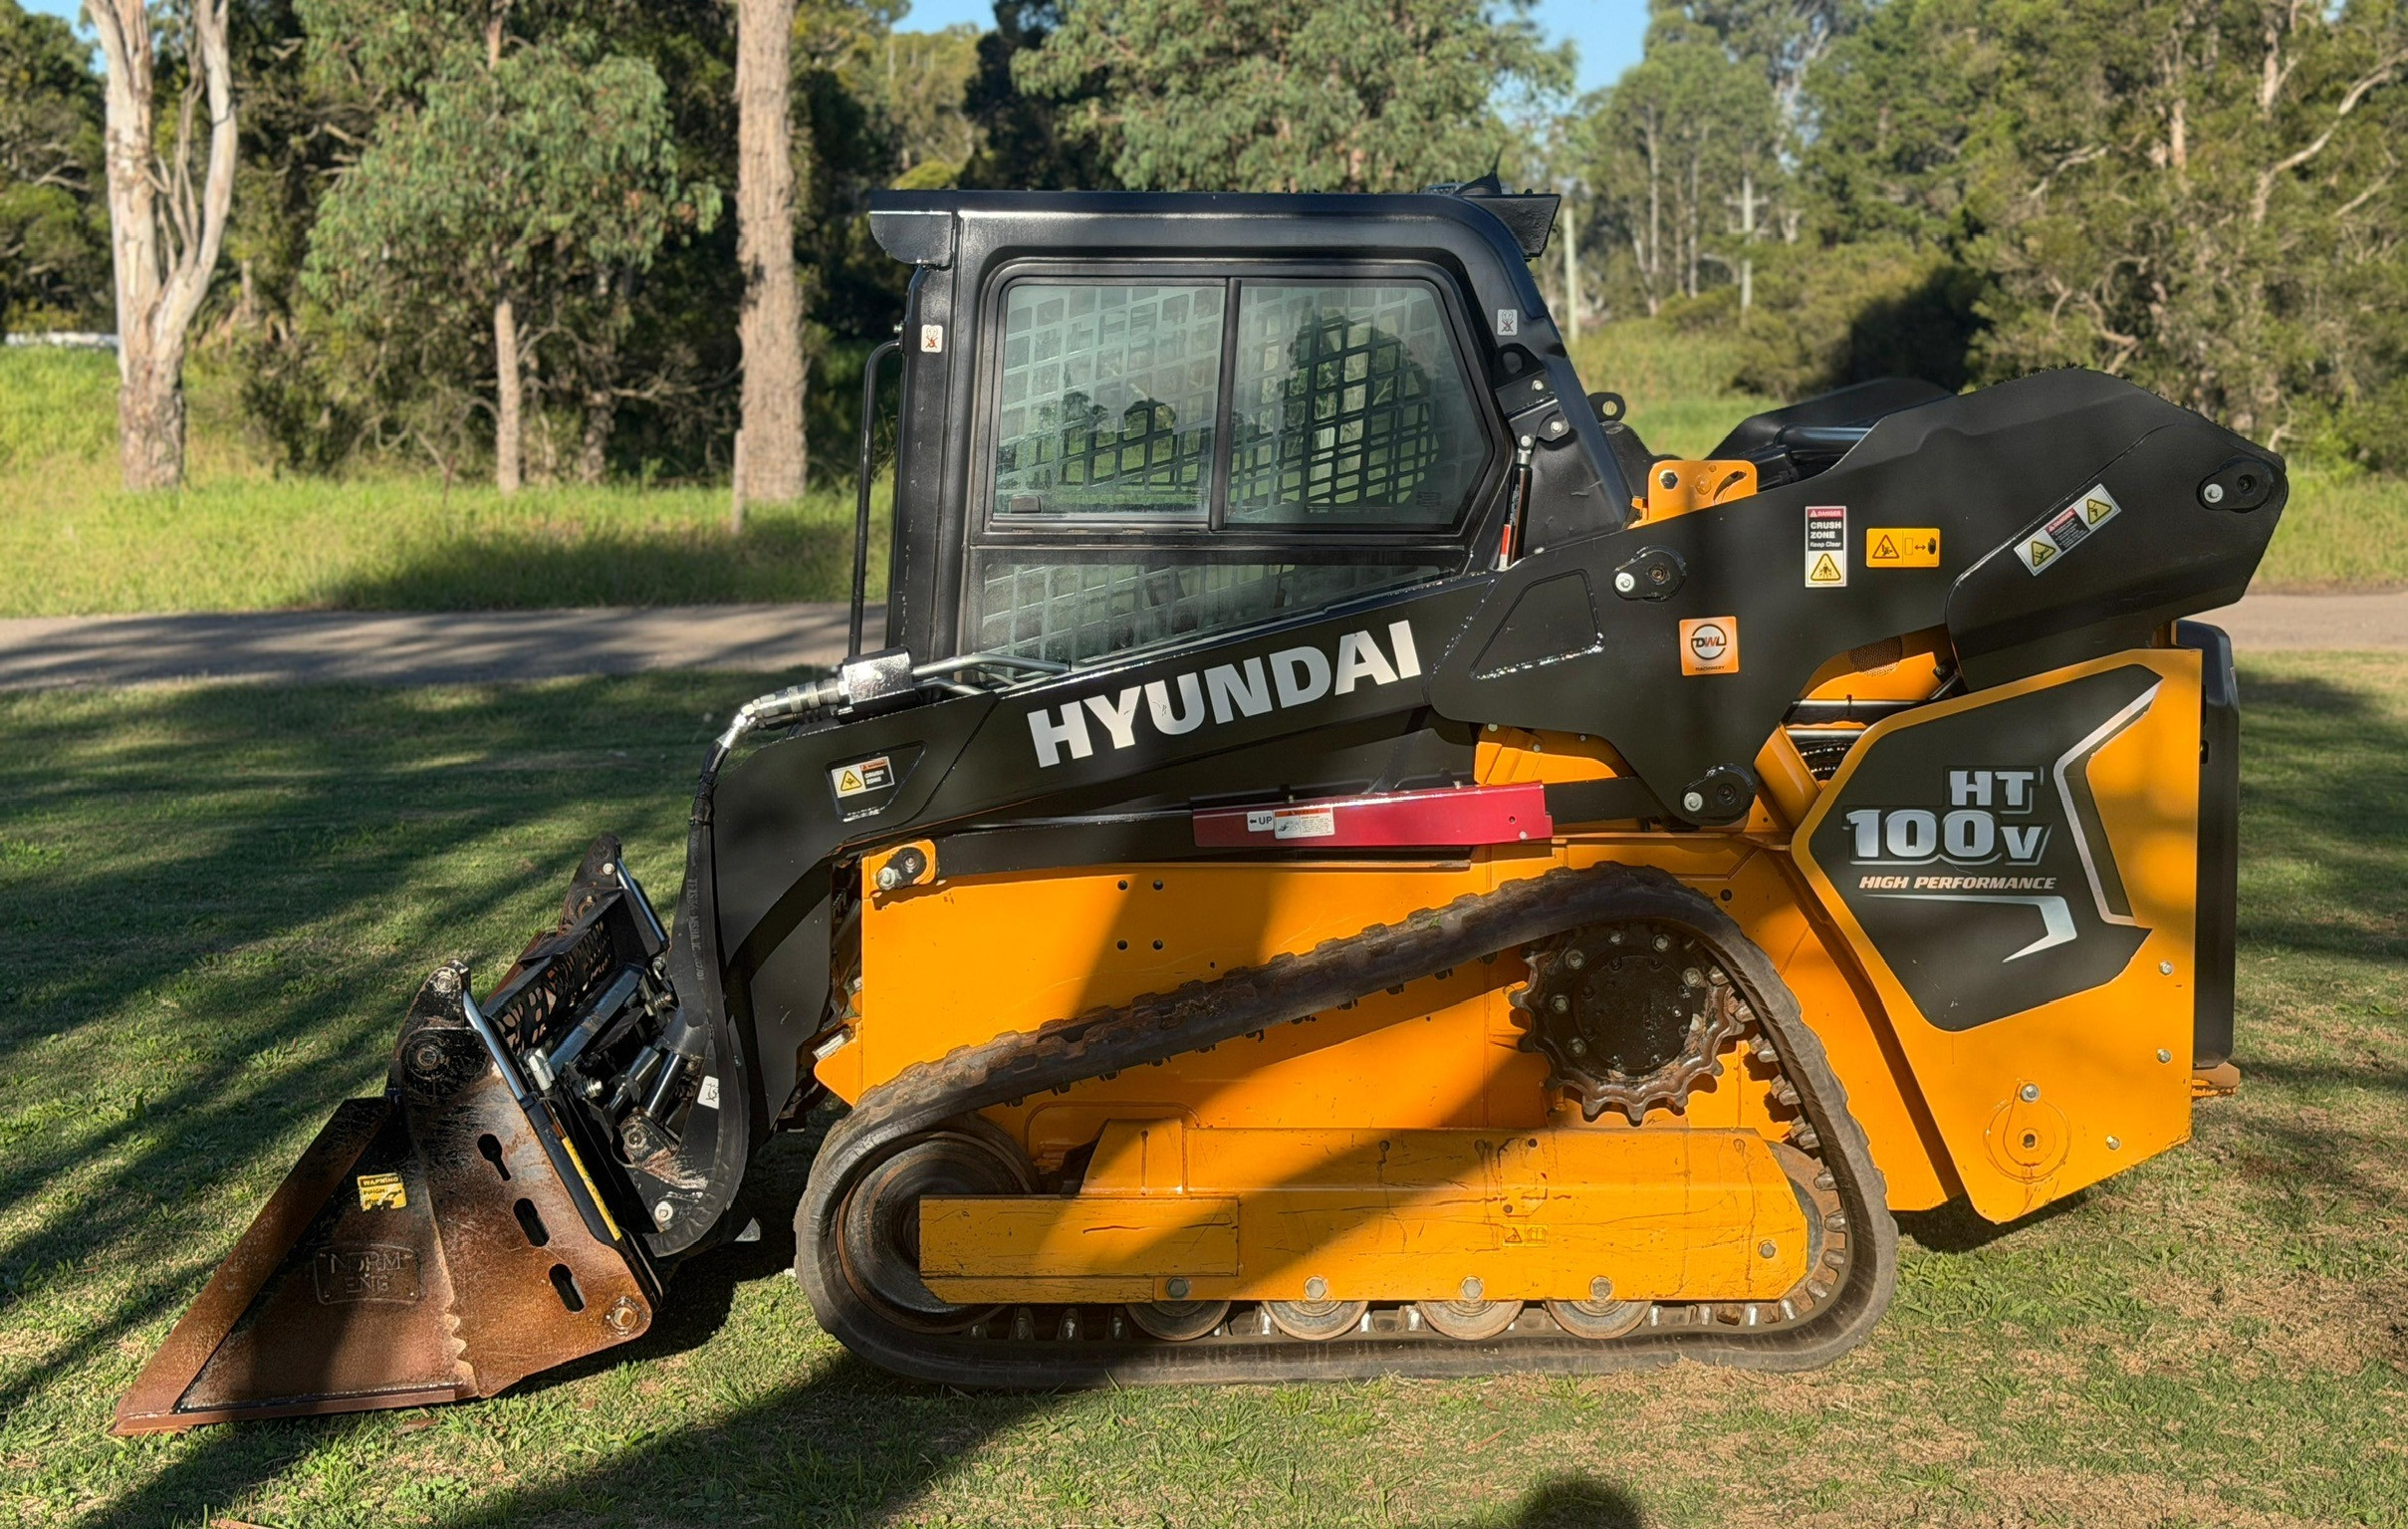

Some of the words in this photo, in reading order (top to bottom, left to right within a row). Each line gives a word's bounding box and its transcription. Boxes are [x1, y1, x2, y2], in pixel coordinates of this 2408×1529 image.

[1809, 521, 1842, 530] CRUSH
[1693, 637, 1726, 647] DWL
[1027, 620, 1421, 768] HYUNDAI
[1949, 770, 2035, 806] HT
[1258, 816, 1273, 825] UP
[1859, 877, 1910, 890] HIGH
[1914, 877, 2057, 890] PERFORMANCE
